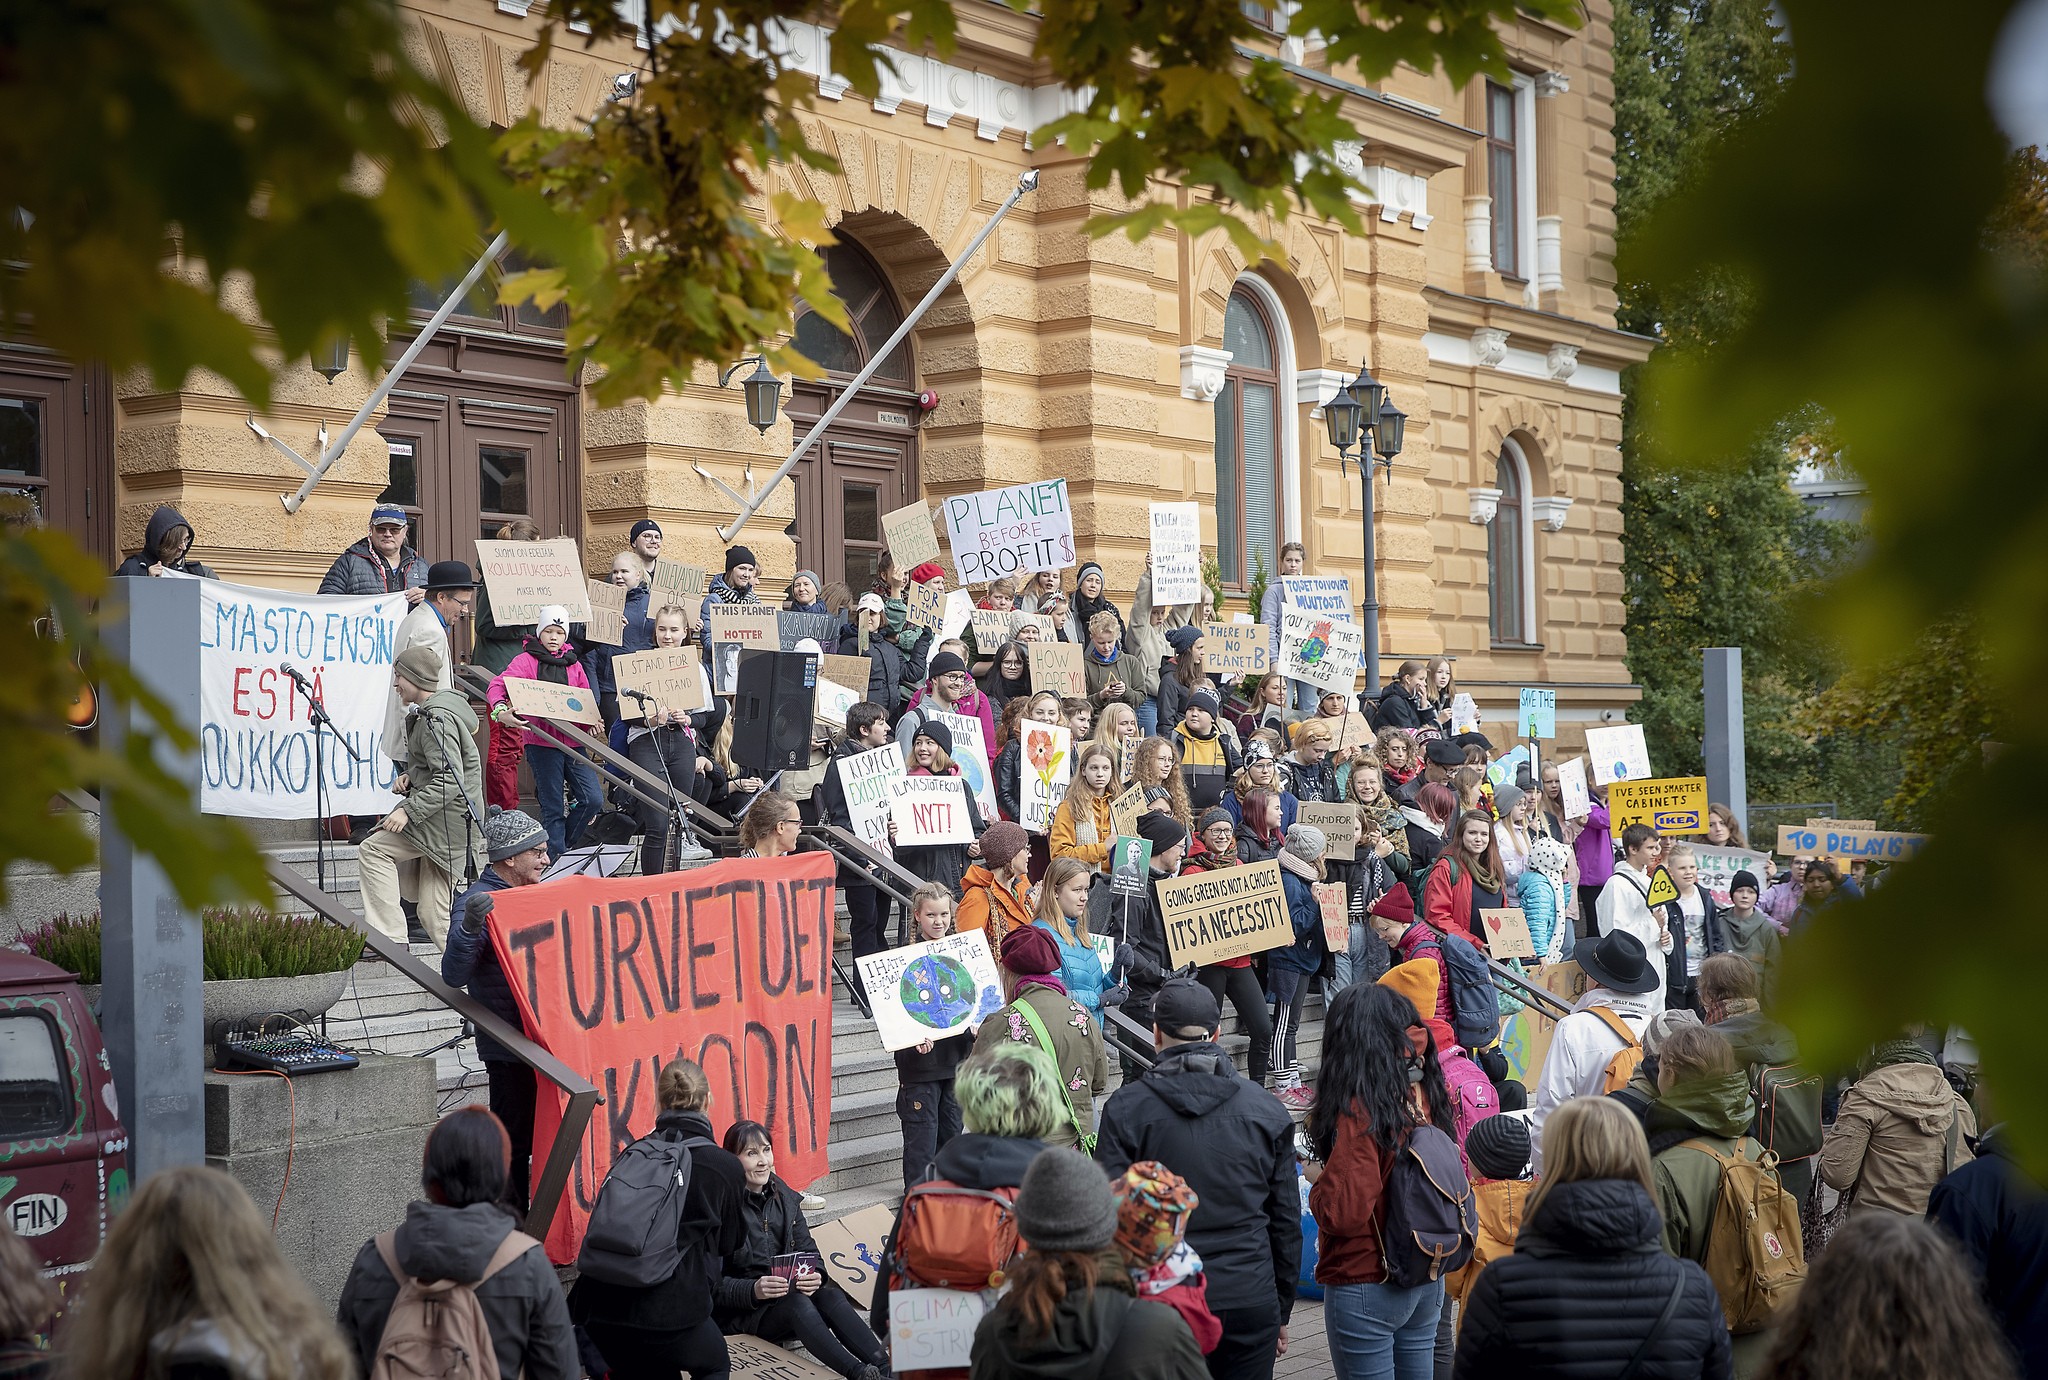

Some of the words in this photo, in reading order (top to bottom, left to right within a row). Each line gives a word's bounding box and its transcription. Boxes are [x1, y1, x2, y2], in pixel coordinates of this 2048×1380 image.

[950, 477, 1065, 534] PLANET
[978, 521, 1042, 550] BEFORE
[485, 561, 573, 578] KOULUTUKSESSA
[1286, 580, 1312, 593] TOISET
[1313, 579, 1349, 592] TOIVOVAT
[917, 585, 940, 609] FOR
[1295, 595, 1346, 611] MUUTOSTA
[712, 606, 739, 616] THIS
[741, 606, 776, 616] PLANET
[909, 603, 944, 631] FUTURE
[200, 602, 315, 660] MASTO
[724, 629, 763, 640] HOTTER
[1209, 626, 1240, 638] THERE
[1245, 628, 1256, 640] IS
[1337, 630, 1354, 643] THE
[1225, 640, 1240, 652] NO
[619, 661, 624, 677] I
[631, 657, 665, 675] STAND
[668, 653, 689, 668] FOR
[1035, 649, 1070, 670] HOW
[1209, 653, 1252, 668] PLANET
[1254, 646, 1265, 669] B
[1312, 659, 1340, 674] STILL
[1035, 671, 1068, 695] DARE
[1068, 671, 1086, 694] YOU
[1289, 663, 1310, 675] THE
[1312, 670, 1332, 682] LIES
[232, 666, 327, 722] ESTÄ
[664, 677, 692, 693] STAND
[1520, 688, 1537, 708] SAVE
[1538, 690, 1554, 709] THE
[848, 747, 896, 780] RESPECT
[1615, 787, 1633, 797] I'VE
[1638, 784, 1661, 796] SEEN
[1664, 783, 1702, 794] SMARTER
[1114, 797, 1130, 818] TIME
[1626, 795, 1687, 809] CABINETS
[912, 803, 952, 835] NYT!
[1300, 805, 1307, 824] I
[1307, 814, 1335, 825] STAND
[1335, 815, 1352, 825] FOR
[1659, 816, 1695, 825] IKEA
[1327, 832, 1352, 842] STAND
[1786, 830, 1818, 850] TO
[1826, 833, 1886, 856] DELAY
[1887, 837, 1904, 858] IS
[1727, 856, 1752, 871] UP
[1165, 886, 1194, 908] GOING
[1193, 881, 1220, 902] GREEN
[1219, 880, 1228, 896] IS
[1227, 877, 1243, 894] NOT
[1243, 876, 1250, 892] A
[1249, 869, 1278, 890] CHOICE
[1170, 918, 1198, 951] IT'S
[1198, 915, 1212, 945] A
[1208, 895, 1285, 942] NECESSITY
[1504, 916, 1519, 928] THIS
[510, 876, 834, 1030] TURVETUET
[958, 945, 981, 963] ME
[1501, 938, 1527, 953] PLANET
[865, 962, 873, 979] I
[873, 955, 907, 976] HATE
[866, 971, 901, 994] HUMAN
[1611, 998, 1628, 1006] HELLY
[1628, 1001, 1647, 1009] HANSEN
[13, 1197, 58, 1230] FIN
[894, 1296, 975, 1324] CLIMA
[911, 1328, 975, 1358] STRI
